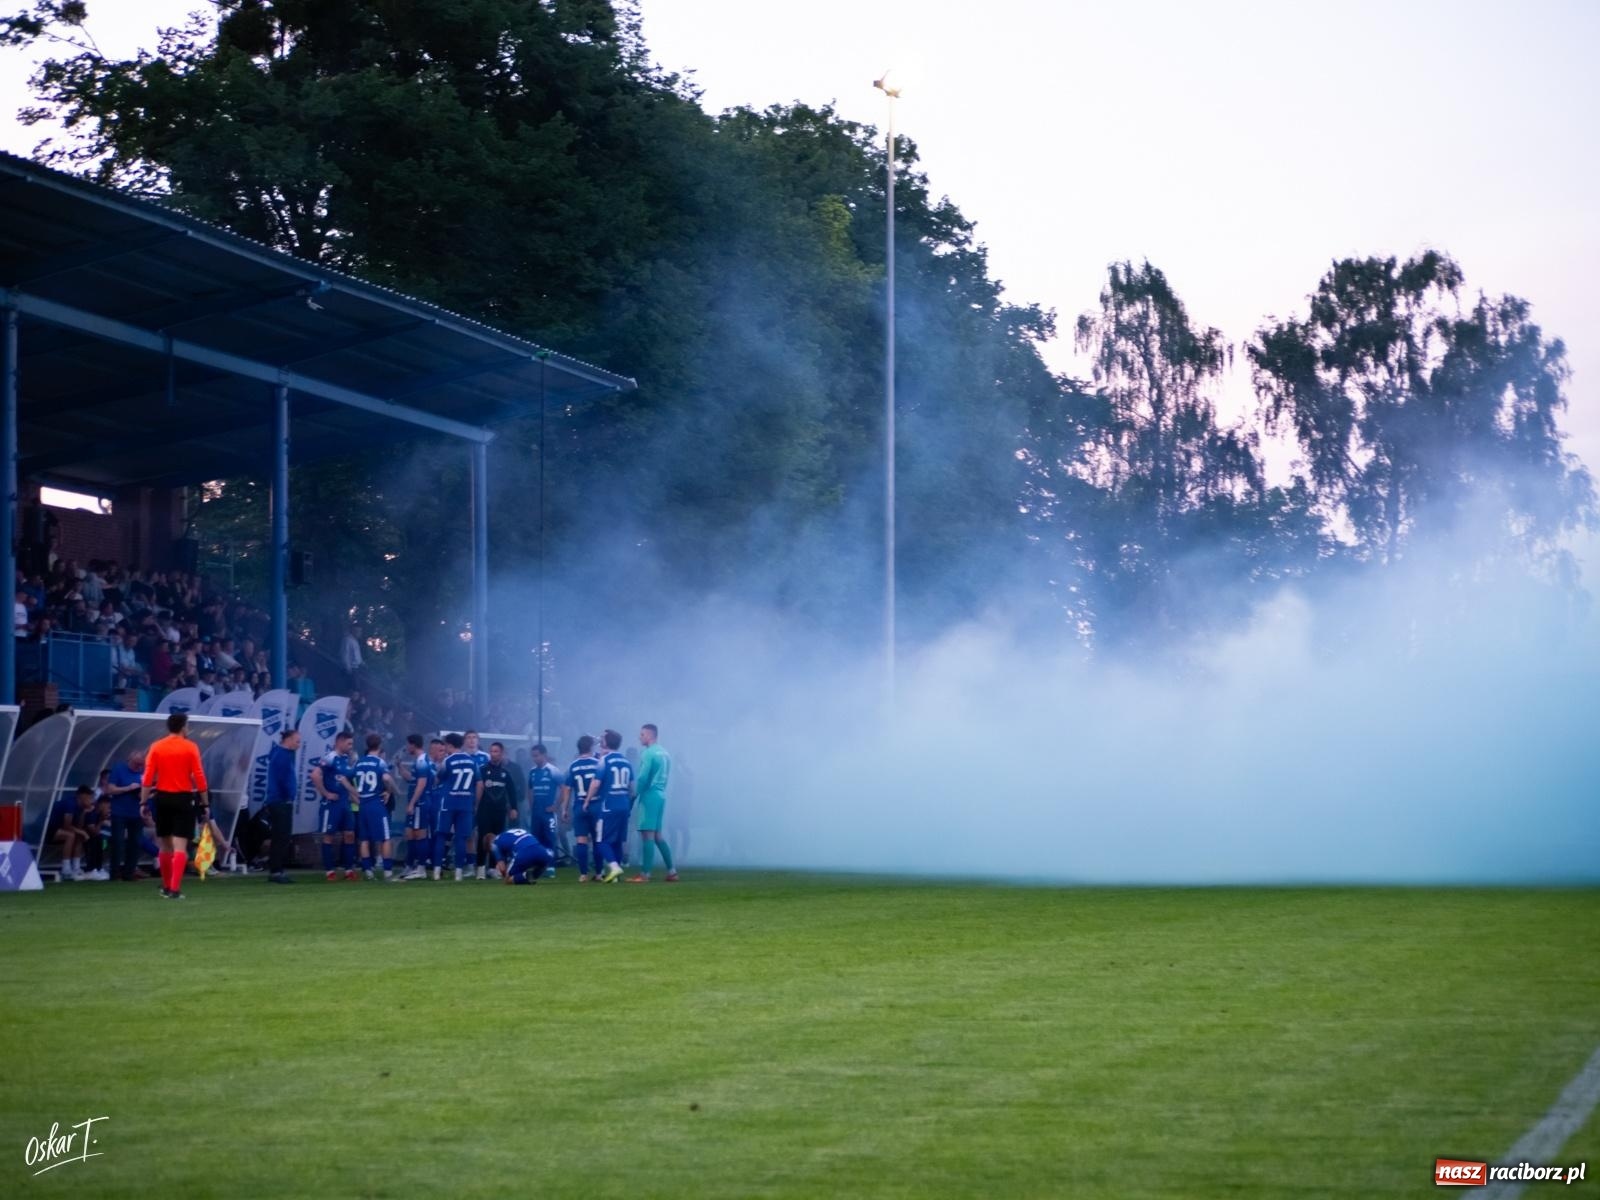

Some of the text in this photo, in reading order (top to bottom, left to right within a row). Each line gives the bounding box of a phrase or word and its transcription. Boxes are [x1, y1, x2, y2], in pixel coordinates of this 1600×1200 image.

[252, 754, 269, 802] UNIA
[356, 771, 377, 793] 79
[452, 768, 474, 790] 77
[611, 767, 630, 788] 10
